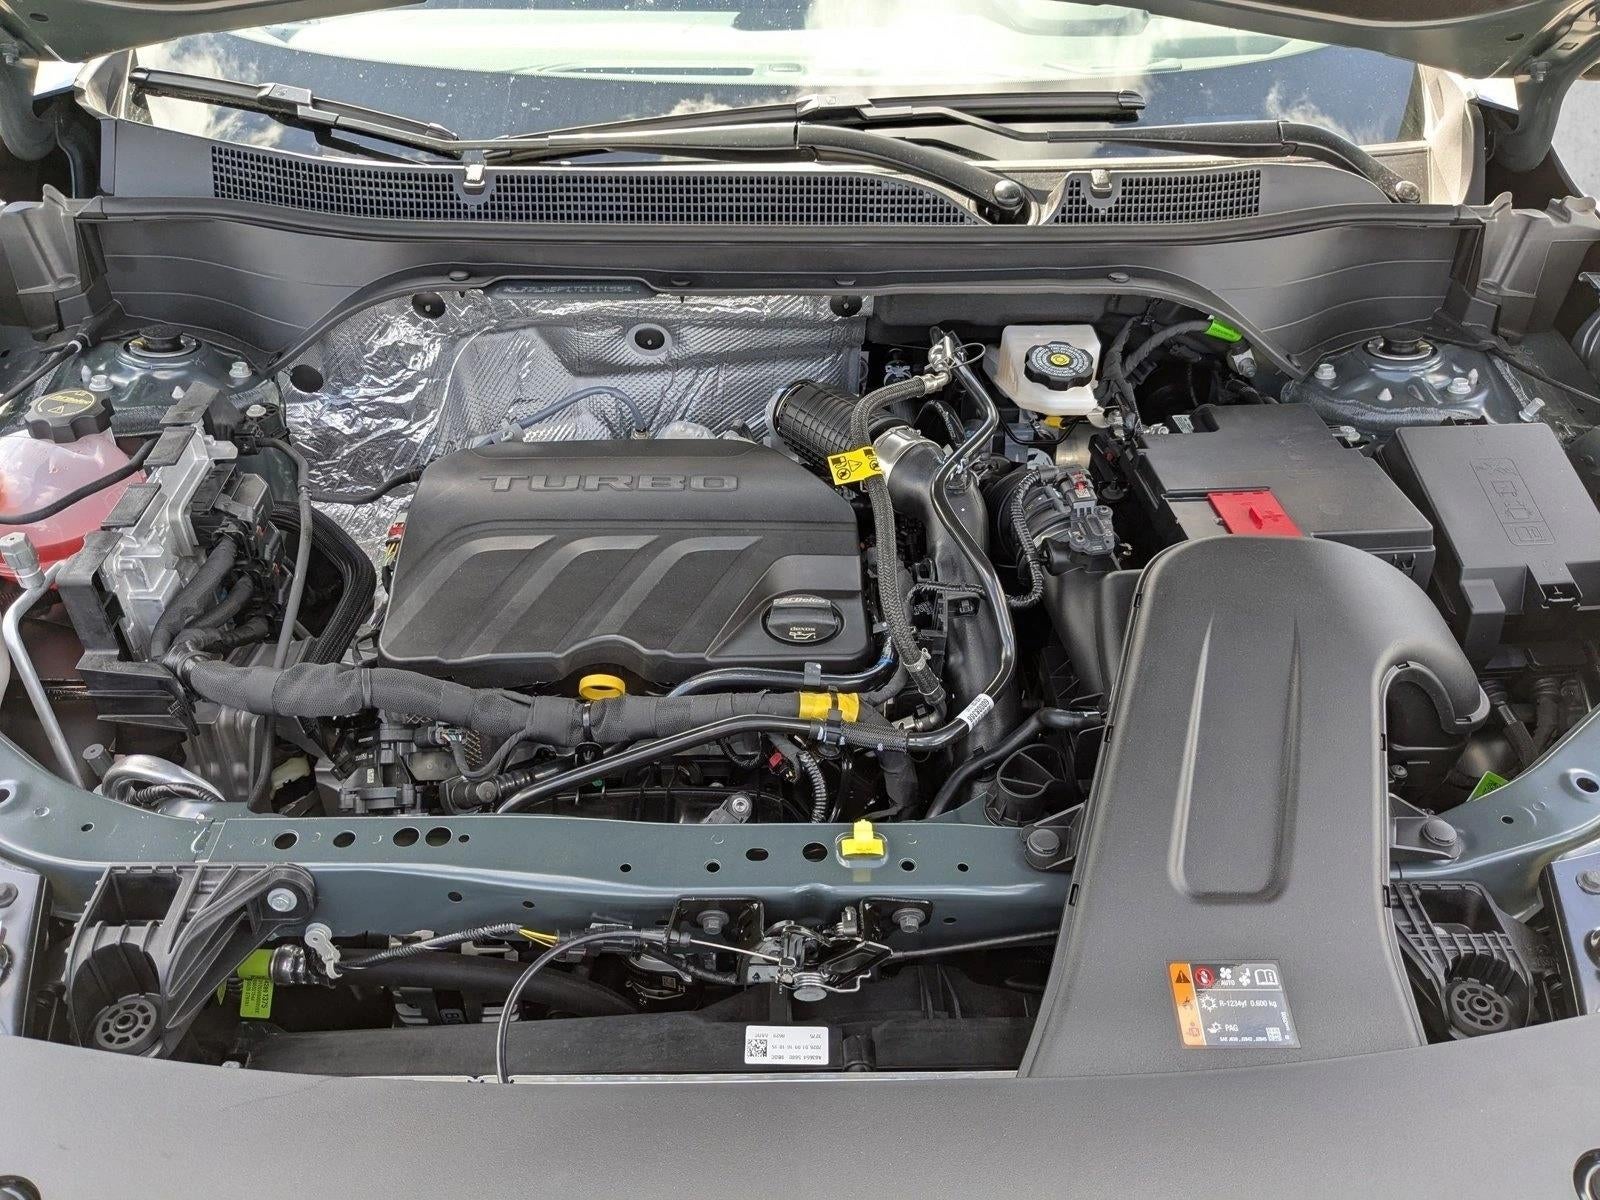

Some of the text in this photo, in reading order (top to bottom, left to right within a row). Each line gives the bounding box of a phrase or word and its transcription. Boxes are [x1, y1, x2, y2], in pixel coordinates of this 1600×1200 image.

[479, 475, 739, 492] TURBO
[1219, 1000, 1247, 1008] R-1234yf
[1269, 1000, 1278, 1008] kg
